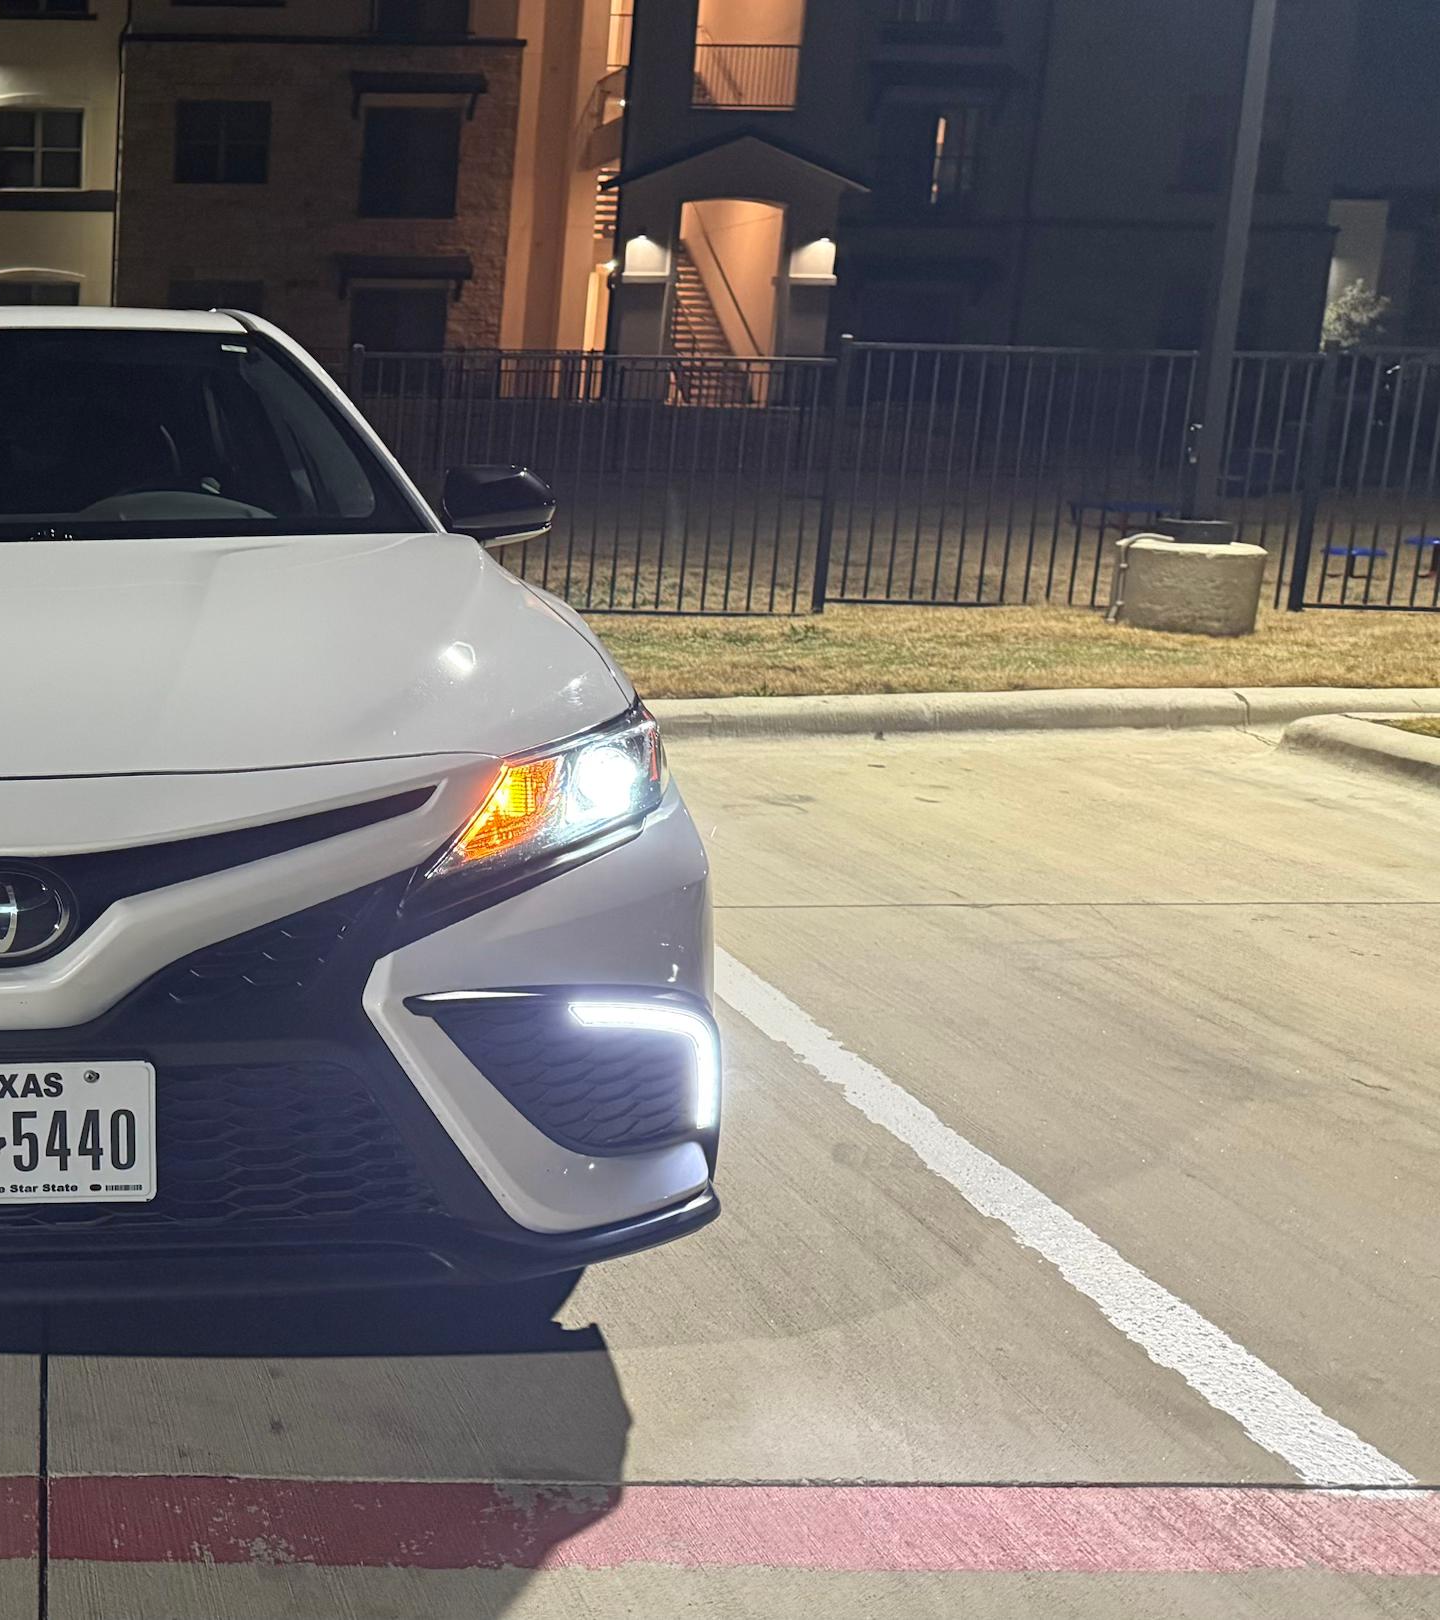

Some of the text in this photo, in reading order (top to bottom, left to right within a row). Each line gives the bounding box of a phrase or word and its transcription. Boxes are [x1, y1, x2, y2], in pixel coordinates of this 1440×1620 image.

[12, 1108, 136, 1173] 5440
[10, 1183, 39, 1193] Star
[43, 1183, 79, 1193] State
